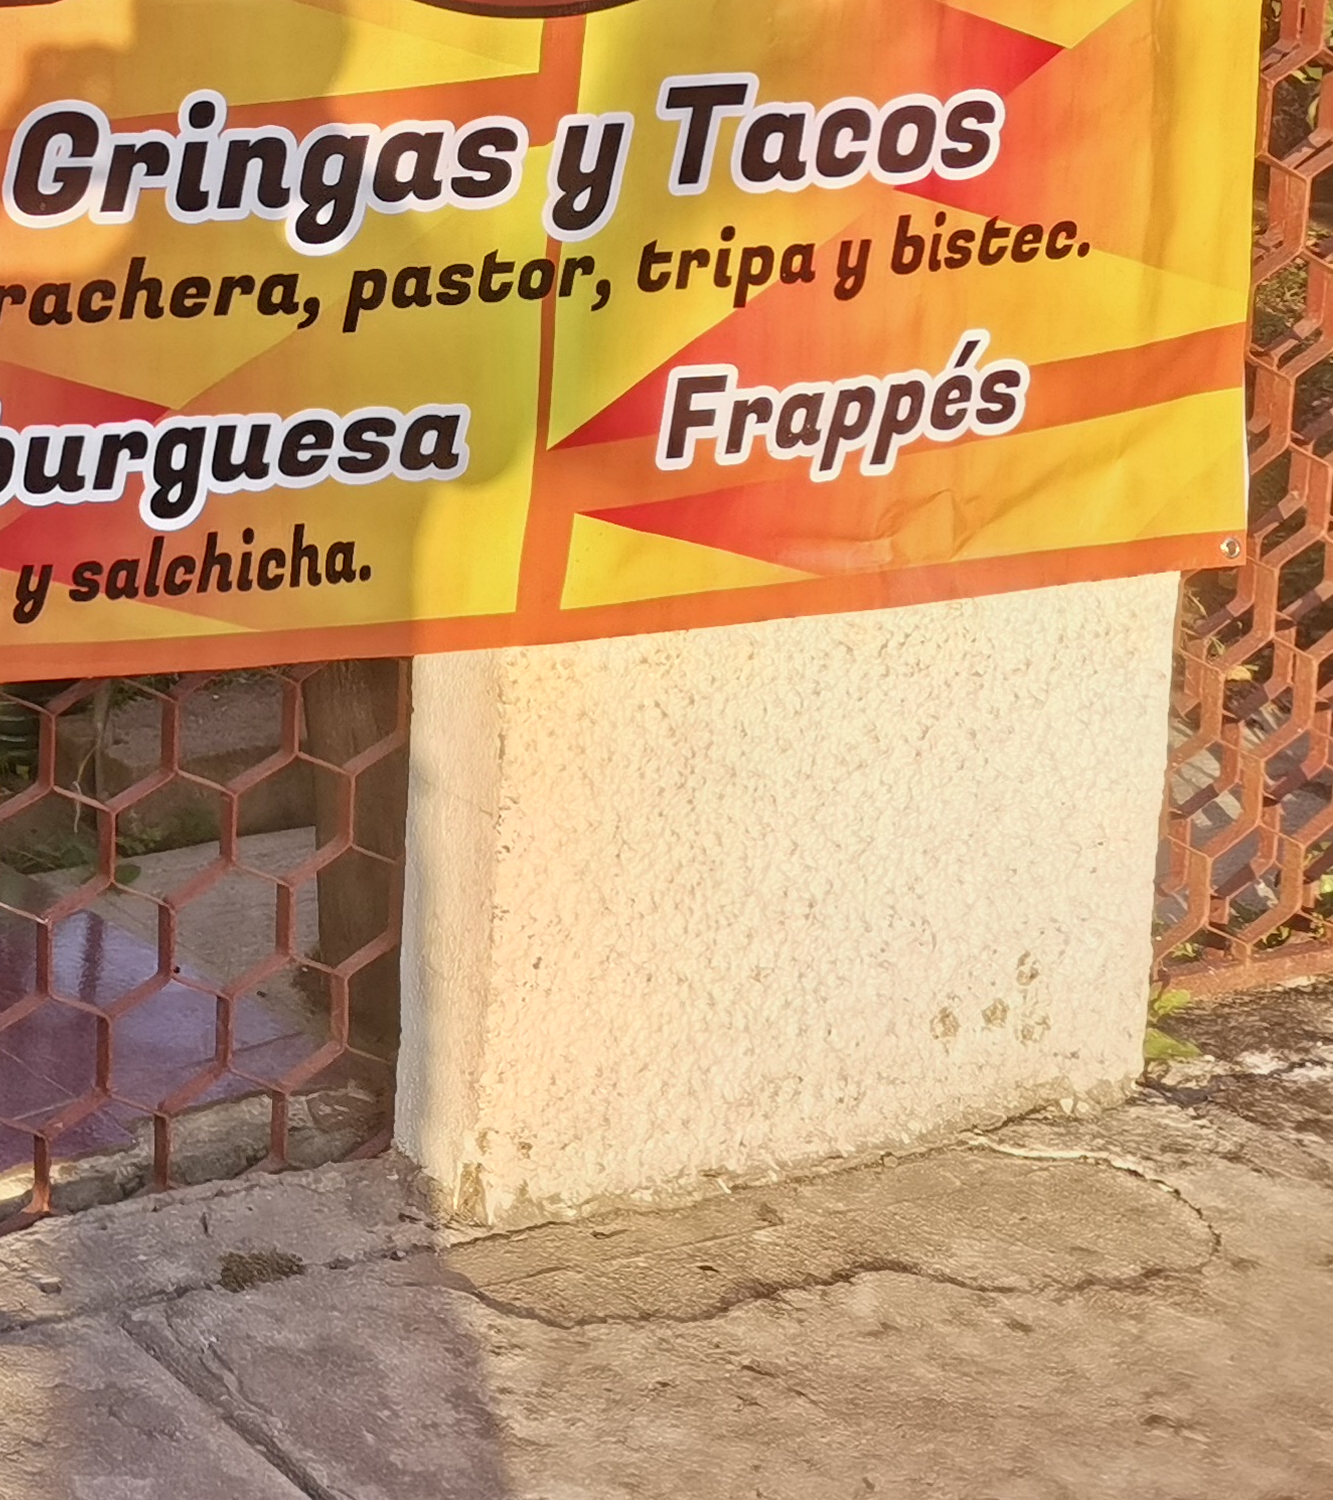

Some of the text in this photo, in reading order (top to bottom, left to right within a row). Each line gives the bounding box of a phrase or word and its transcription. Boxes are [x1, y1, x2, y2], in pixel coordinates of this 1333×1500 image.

[3, 72, 1006, 256] Gringas y Tacos
[343, 248, 610, 332] pastor,
[637, 225, 815, 307] tripa
[833, 237, 870, 298] y
[891, 210, 1092, 276] bistec.
[656, 328, 1030, 483] Frappés
[13, 558, 54, 626] y
[72, 523, 372, 597] salchicha.
